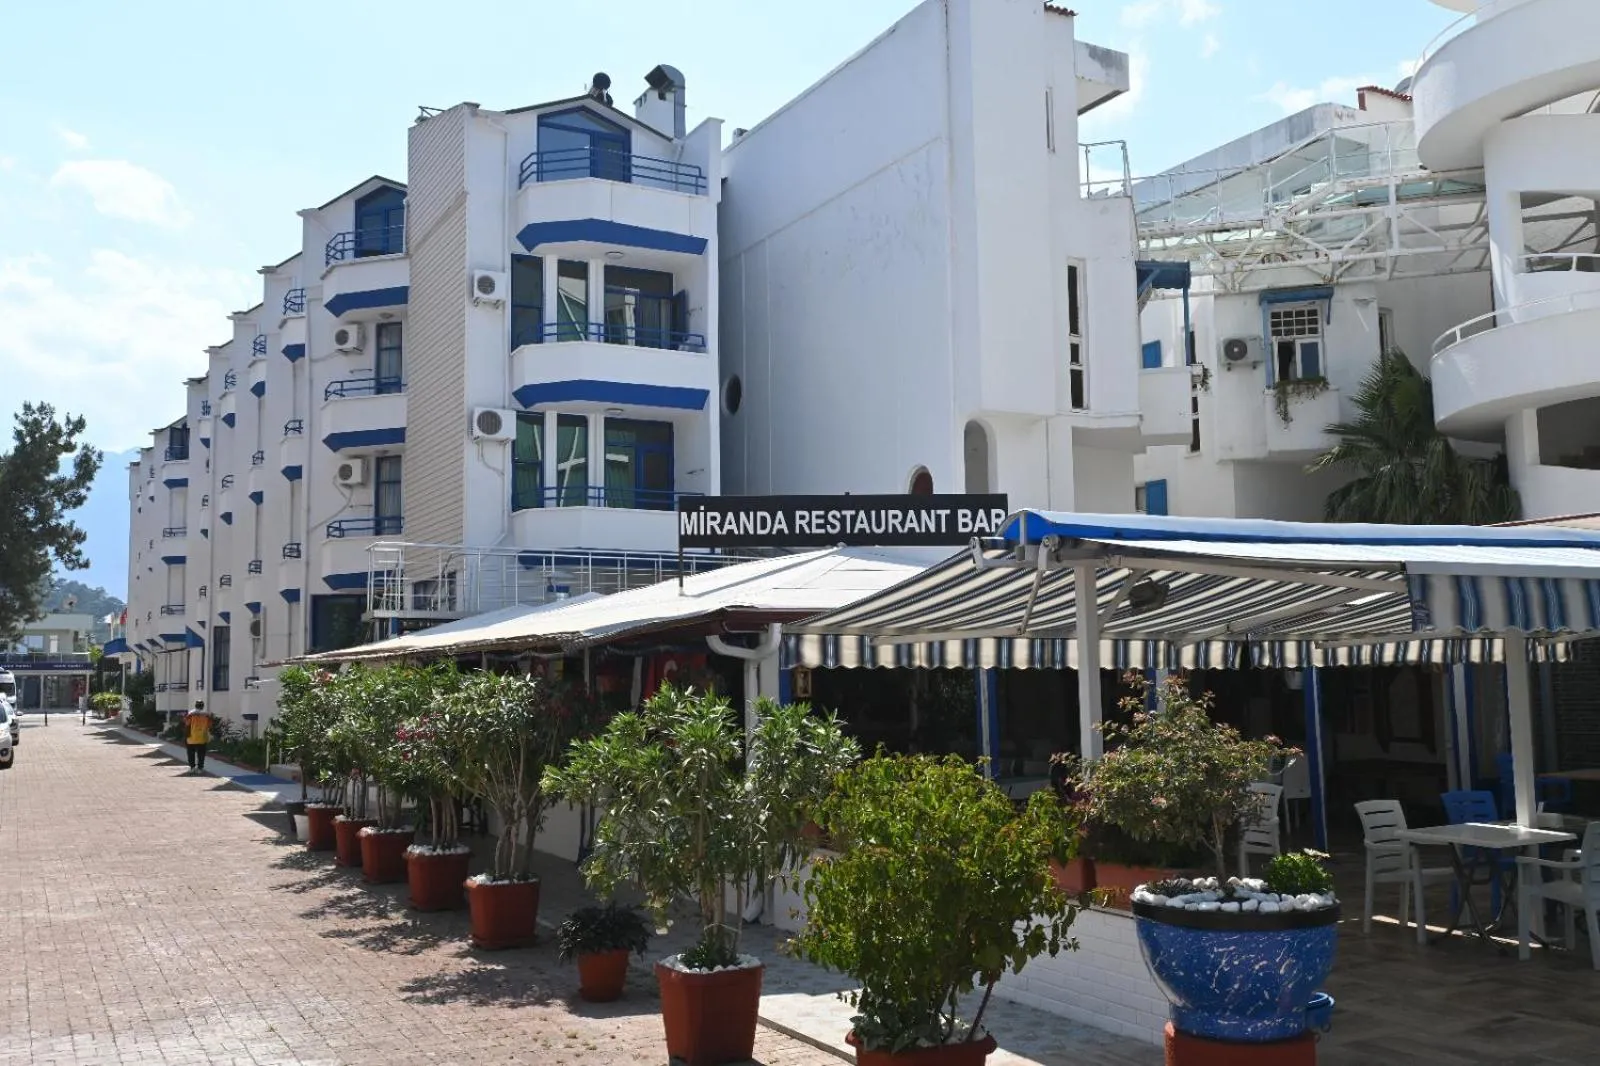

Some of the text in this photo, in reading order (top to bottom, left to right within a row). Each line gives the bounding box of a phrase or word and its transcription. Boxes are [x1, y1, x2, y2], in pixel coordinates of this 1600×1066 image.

[680, 505, 1006, 535] MİRANDA RESTAURANT BAR
